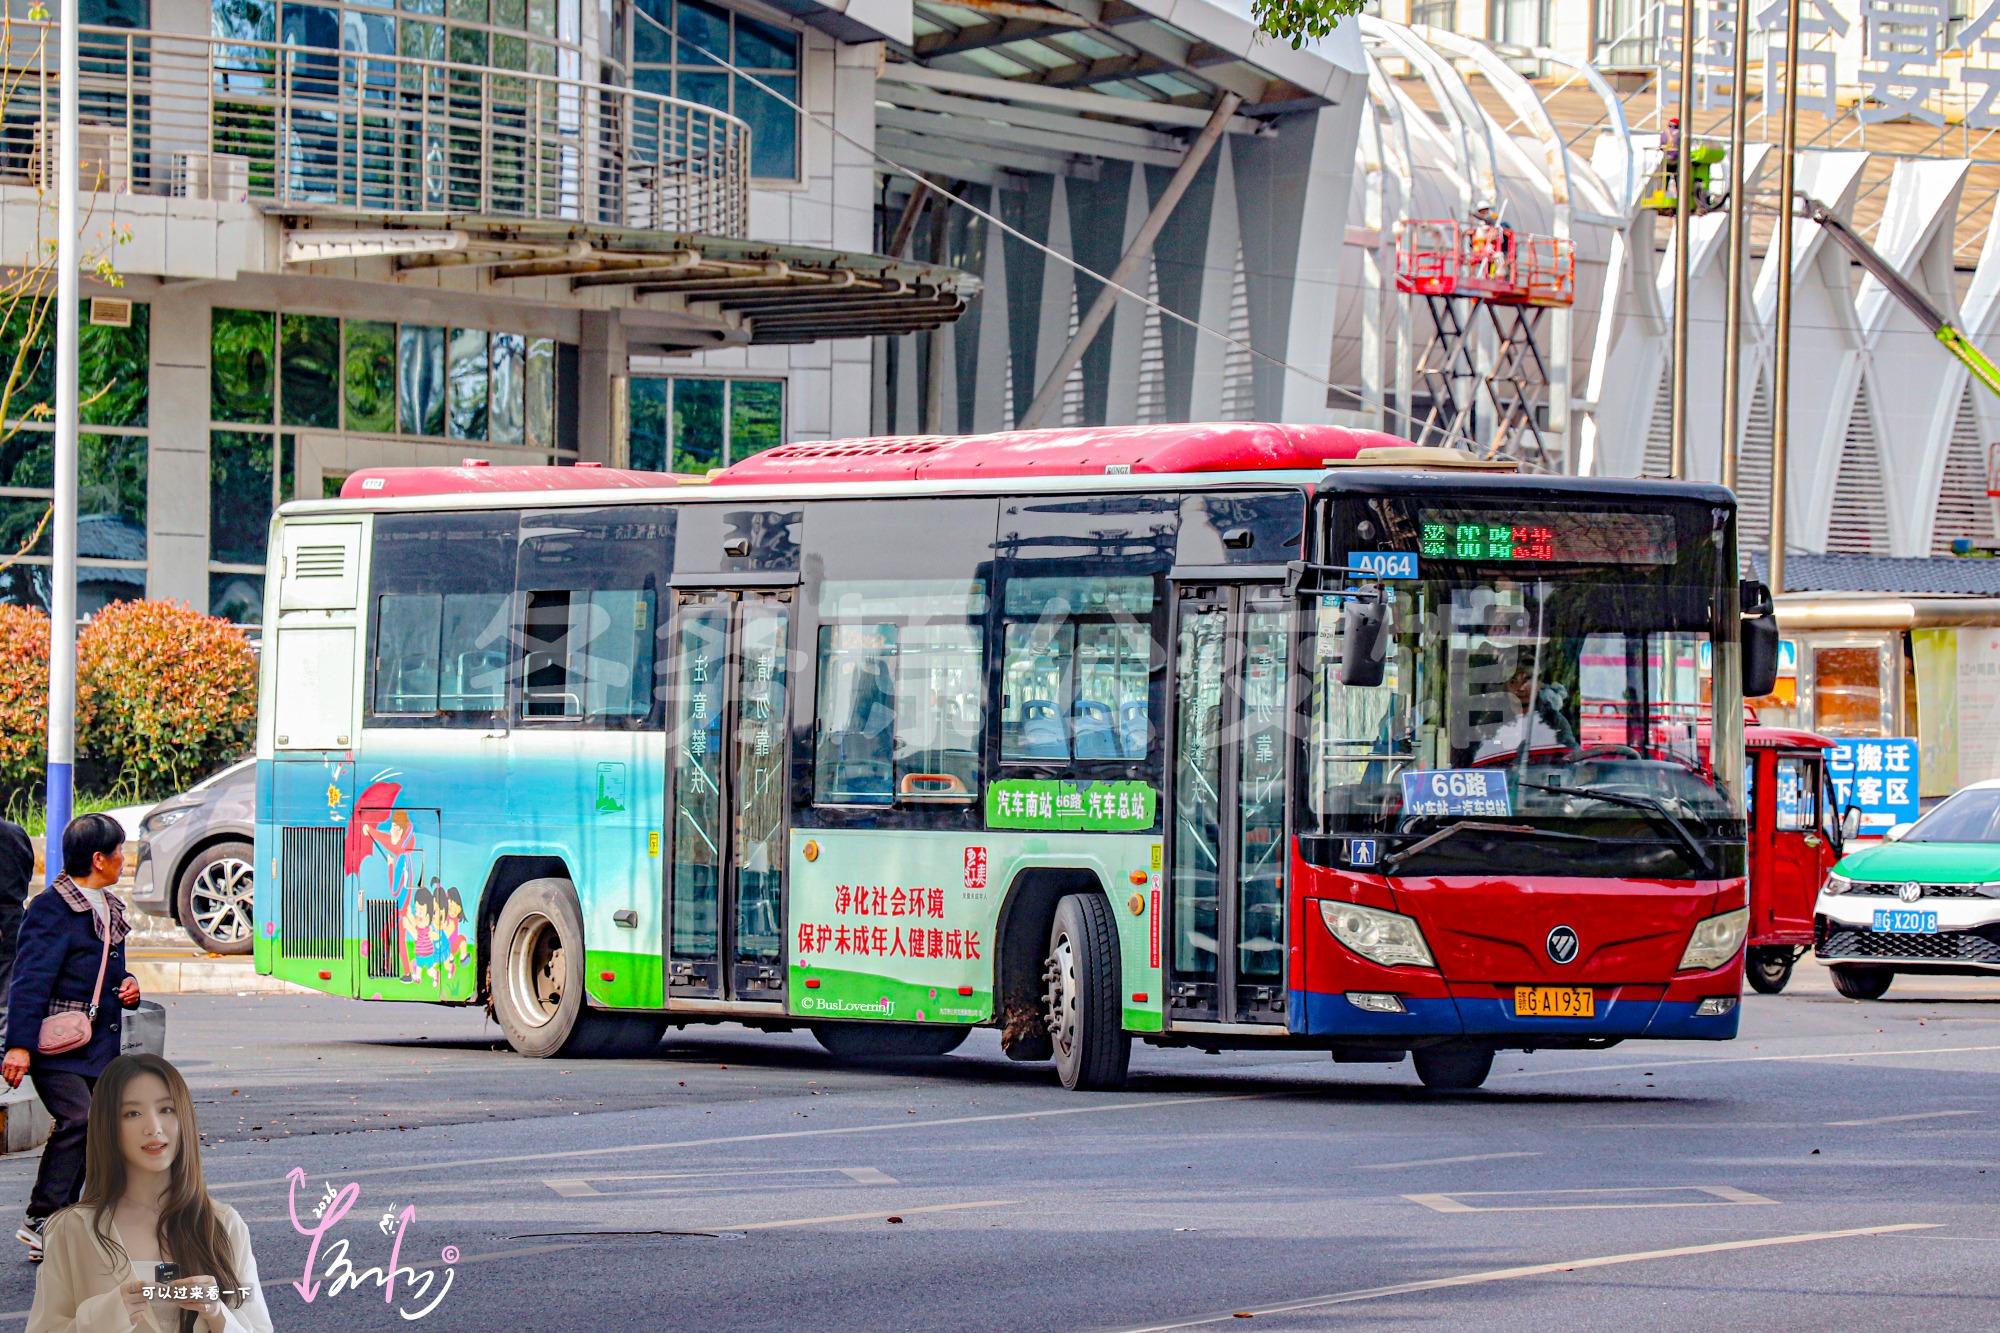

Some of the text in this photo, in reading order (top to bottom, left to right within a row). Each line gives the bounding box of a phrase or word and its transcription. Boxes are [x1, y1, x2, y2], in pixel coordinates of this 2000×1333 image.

[1358, 555, 1411, 576] A064
[1831, 743, 1911, 772] 已搬迁
[1431, 773, 1488, 798] 66路
[1831, 776, 1911, 805] 下客区
[997, 789, 1145, 820] 汽车南站 66路 汽车总站
[1412, 799, 1507, 816] 火车站 汽车总站
[834, 885, 944, 919] 净化社会环境
[797, 922, 982, 960] 保护未成年人健康成长
